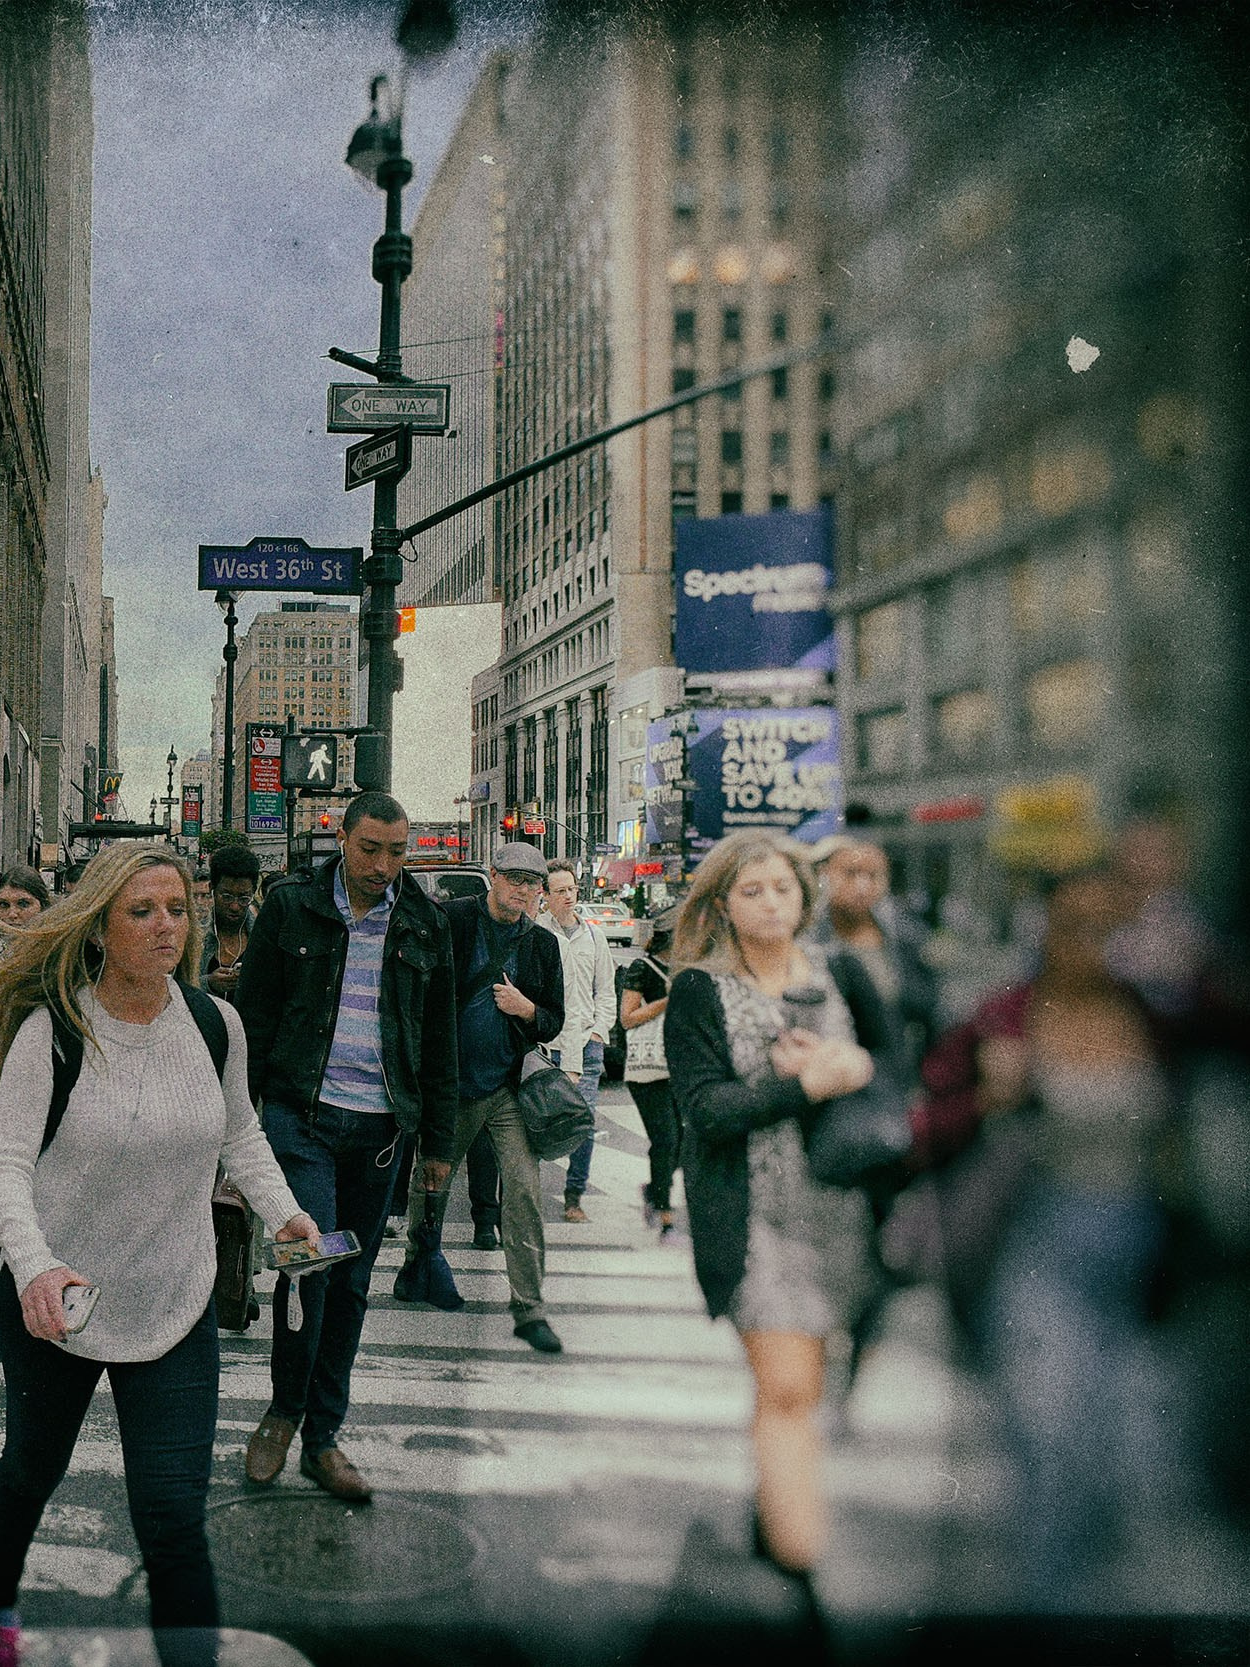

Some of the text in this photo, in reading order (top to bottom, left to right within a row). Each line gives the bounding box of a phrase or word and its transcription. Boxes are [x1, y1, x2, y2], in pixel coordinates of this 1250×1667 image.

[351, 399, 428, 413] ONE WAY
[356, 444, 392, 470] ONE WAY
[257, 543, 299, 553] 120 166
[213, 557, 343, 581] West 36th St
[684, 563, 827, 602] Spect
[721, 739, 787, 763] AND
[721, 785, 764, 809] TO
